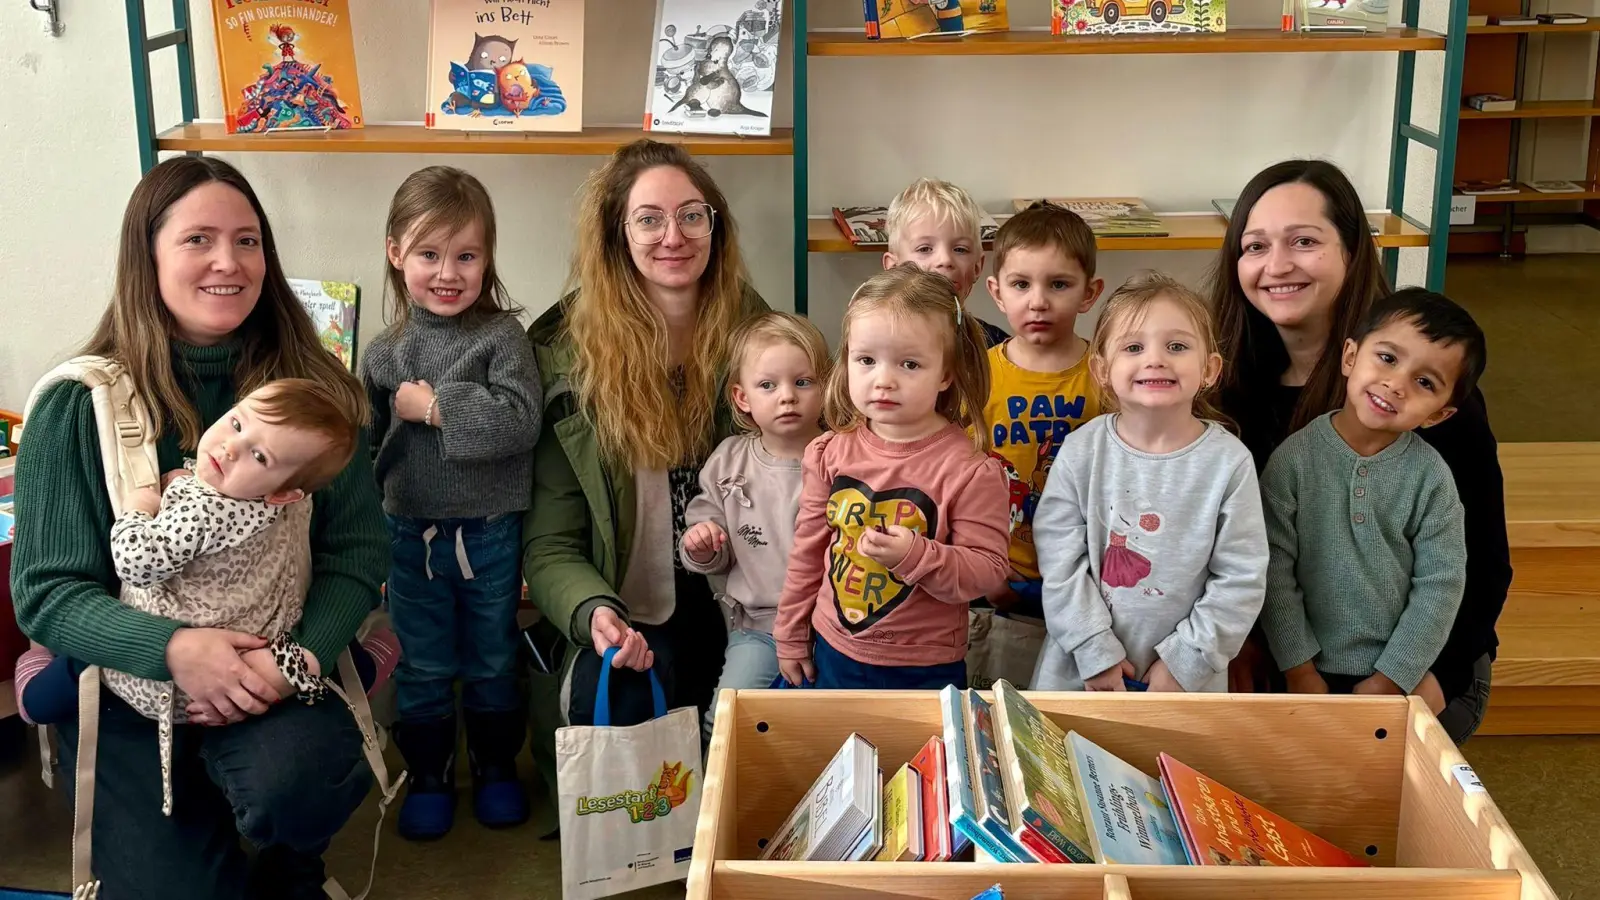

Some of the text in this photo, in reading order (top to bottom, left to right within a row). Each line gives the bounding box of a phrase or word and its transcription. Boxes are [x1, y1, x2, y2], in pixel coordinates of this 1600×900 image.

[225, 16, 238, 29] SO
[256, 5, 339, 27] DURCHEINANDER!
[475, 6, 534, 25] ins Bett
[1007, 395, 1085, 419] PAW
[993, 420, 1076, 447] PATR
[826, 498, 887, 526] GIRL
[578, 787, 658, 813] Lesestart
[1108, 783, 1131, 834] Frühlings-
[1120, 785, 1152, 850] Wimmelbuch
[1254, 813, 1289, 861] Gast
